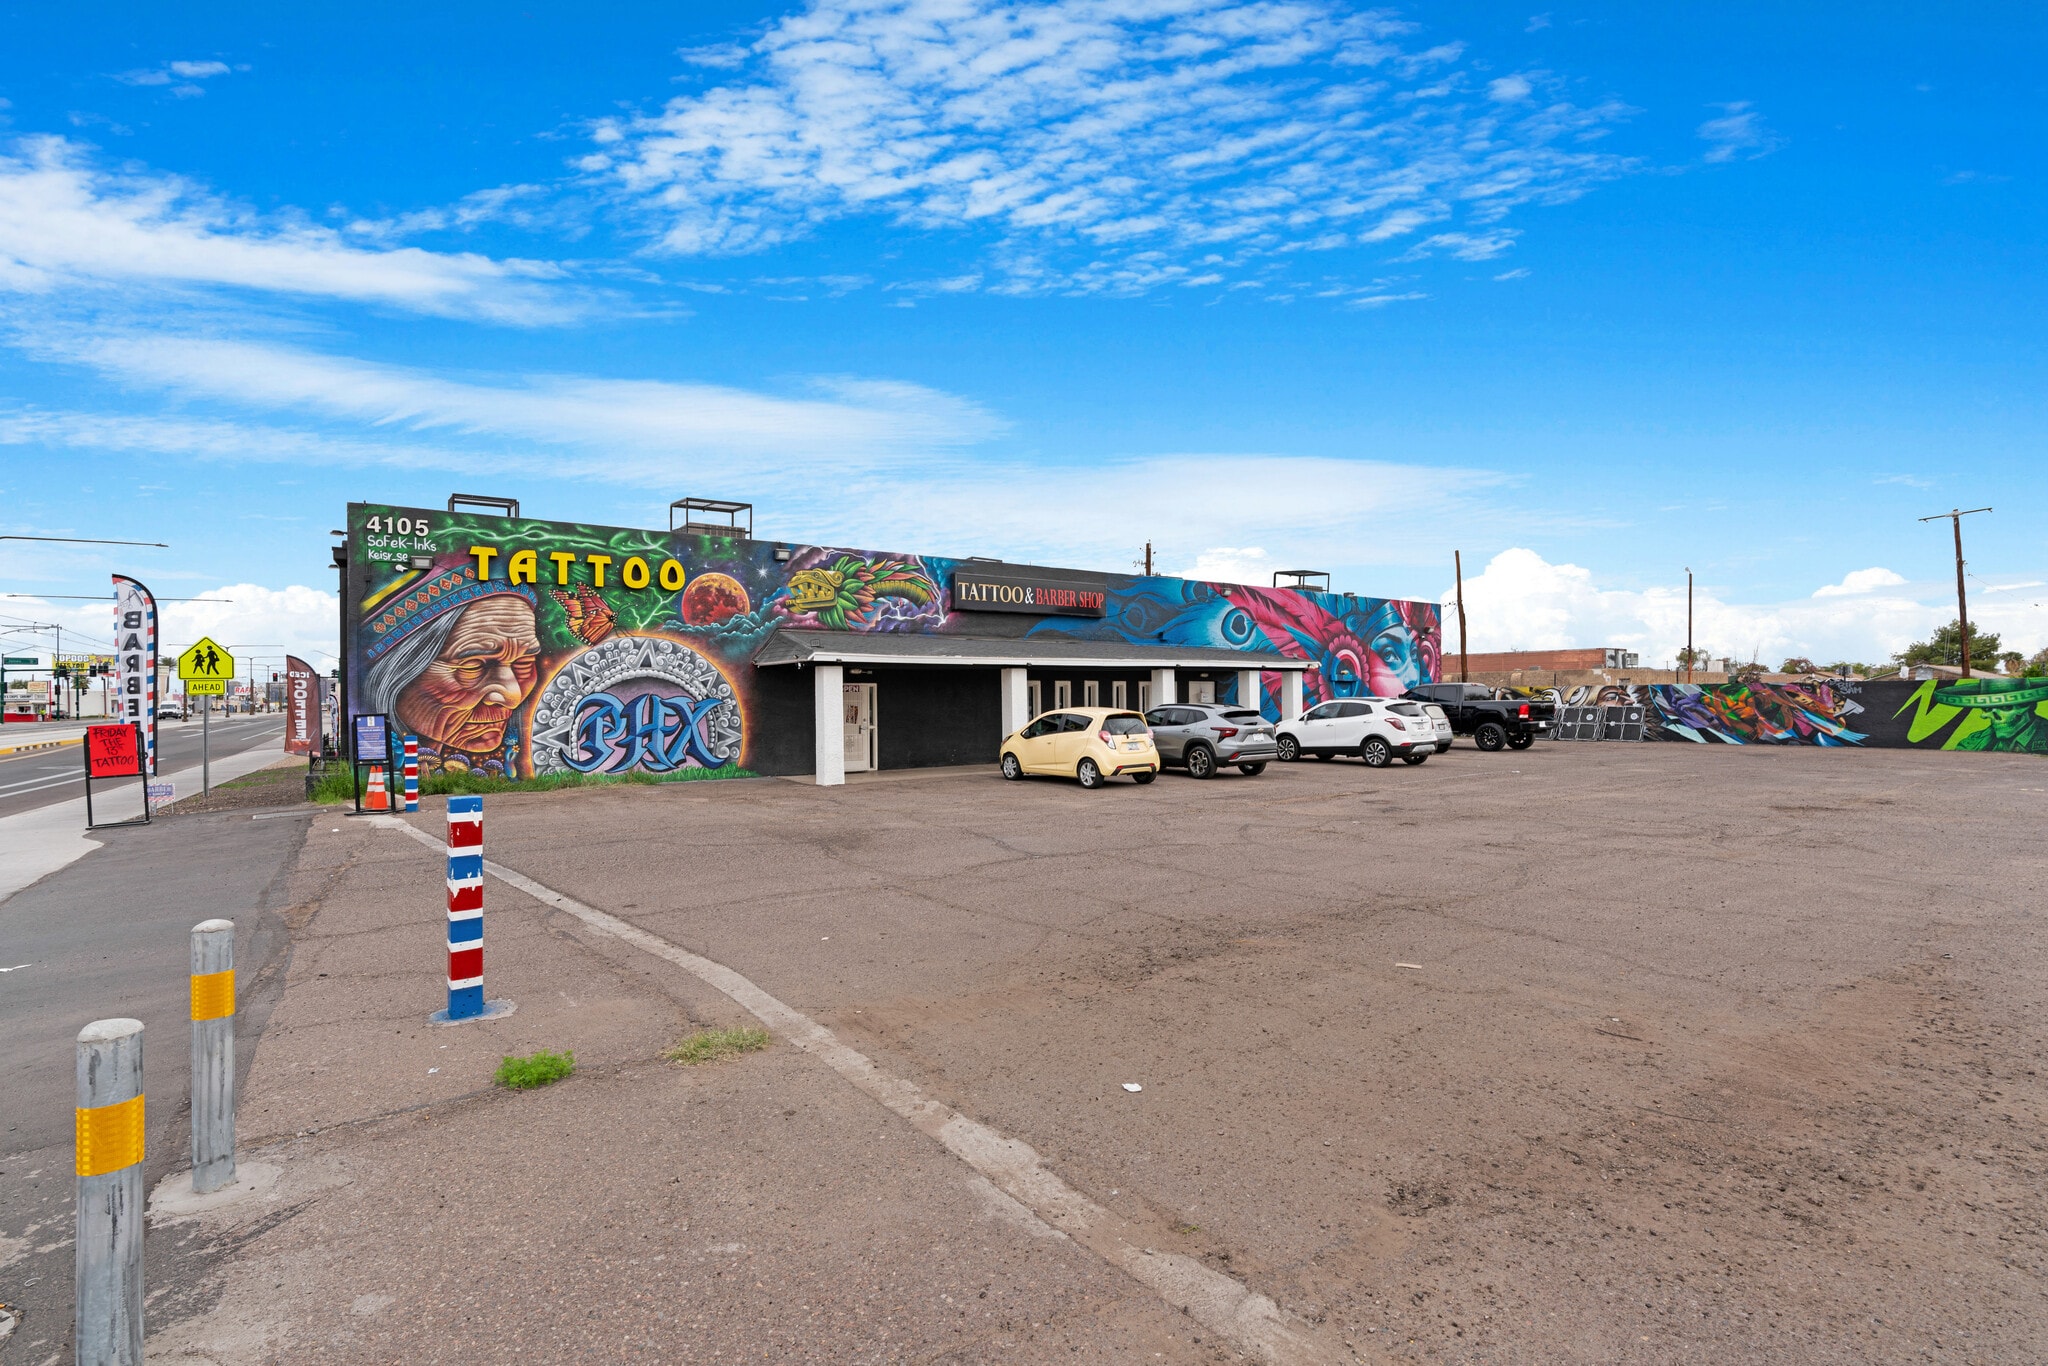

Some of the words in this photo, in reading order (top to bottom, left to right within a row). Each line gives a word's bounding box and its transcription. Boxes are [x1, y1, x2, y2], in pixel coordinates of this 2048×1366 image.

[366, 516, 429, 537] 4105
[469, 545, 686, 591] TATTOO
[958, 582, 1024, 604] TATTOO
[1025, 587, 1034, 604] &
[1036, 587, 1077, 607] BARBER
[1079, 591, 1104, 609] SHOP
[192, 683, 221, 691] AHEAD
[93, 727, 128, 739] FRIDAY
[559, 692, 728, 773] PHX
[100, 738, 126, 748] THE
[92, 755, 134, 767] TATTOO
